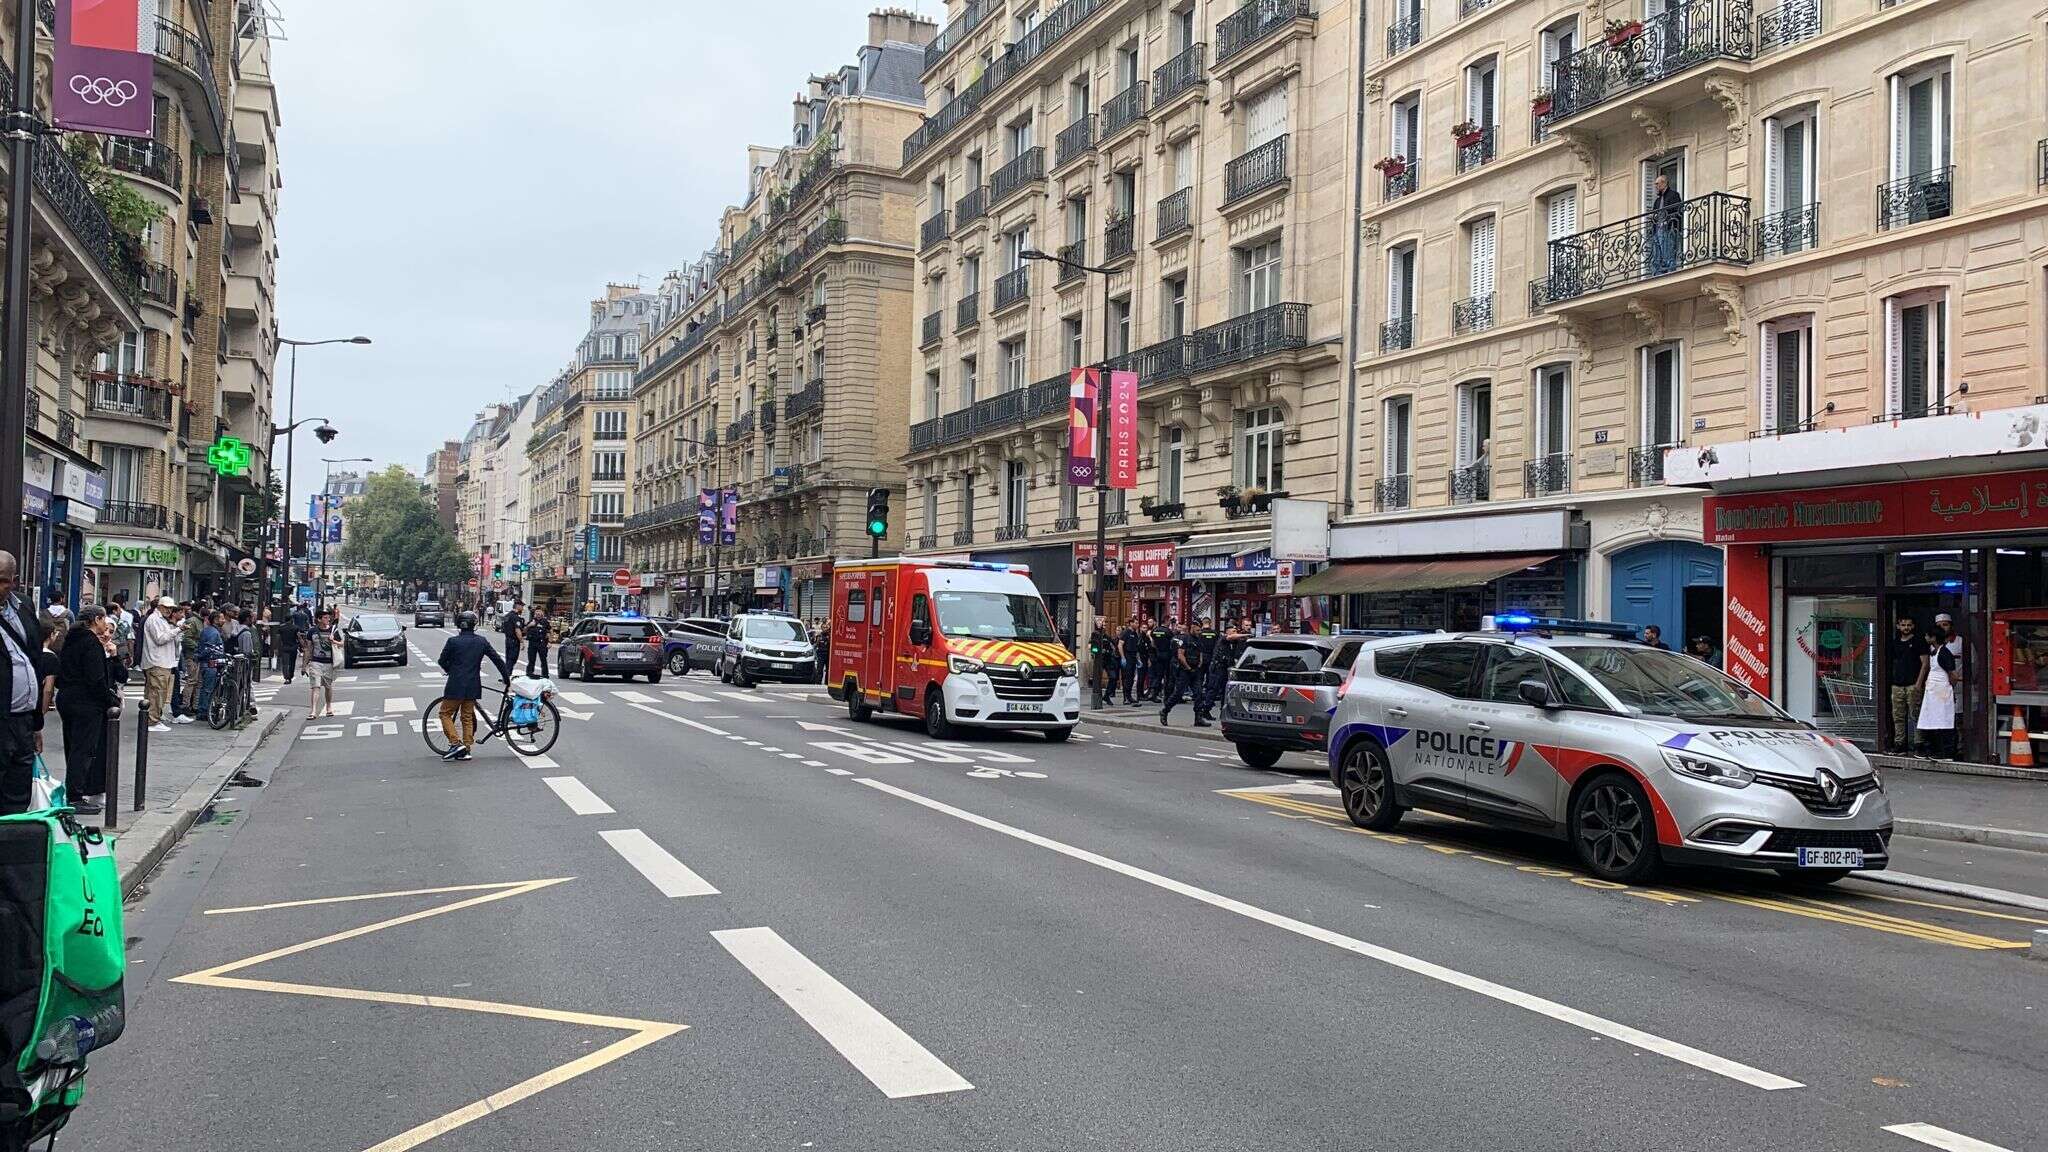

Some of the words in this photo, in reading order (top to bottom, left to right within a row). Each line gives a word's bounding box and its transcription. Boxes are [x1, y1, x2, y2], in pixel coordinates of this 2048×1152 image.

[1119, 381, 1130, 425] 2024
[1118, 431, 1129, 479] PARIS
[1715, 503, 1789, 532] Boucherie
[1792, 498, 1883, 528] Musulmane
[1129, 550, 1144, 561] BISMI
[1185, 558, 1205, 570] KABUL
[1205, 556, 1228, 570] MOBILE
[1140, 564, 1159, 577] SALON
[1728, 596, 1766, 637] Boucherie
[1727, 635, 1769, 678] Musulmane
[1239, 684, 1274, 694] POLICE
[1416, 729, 1495, 758] POLICE
[1709, 730, 1812, 742] POLICE
[805, 741, 1037, 764] BUS
[1415, 753, 1495, 775] NATIONALE
